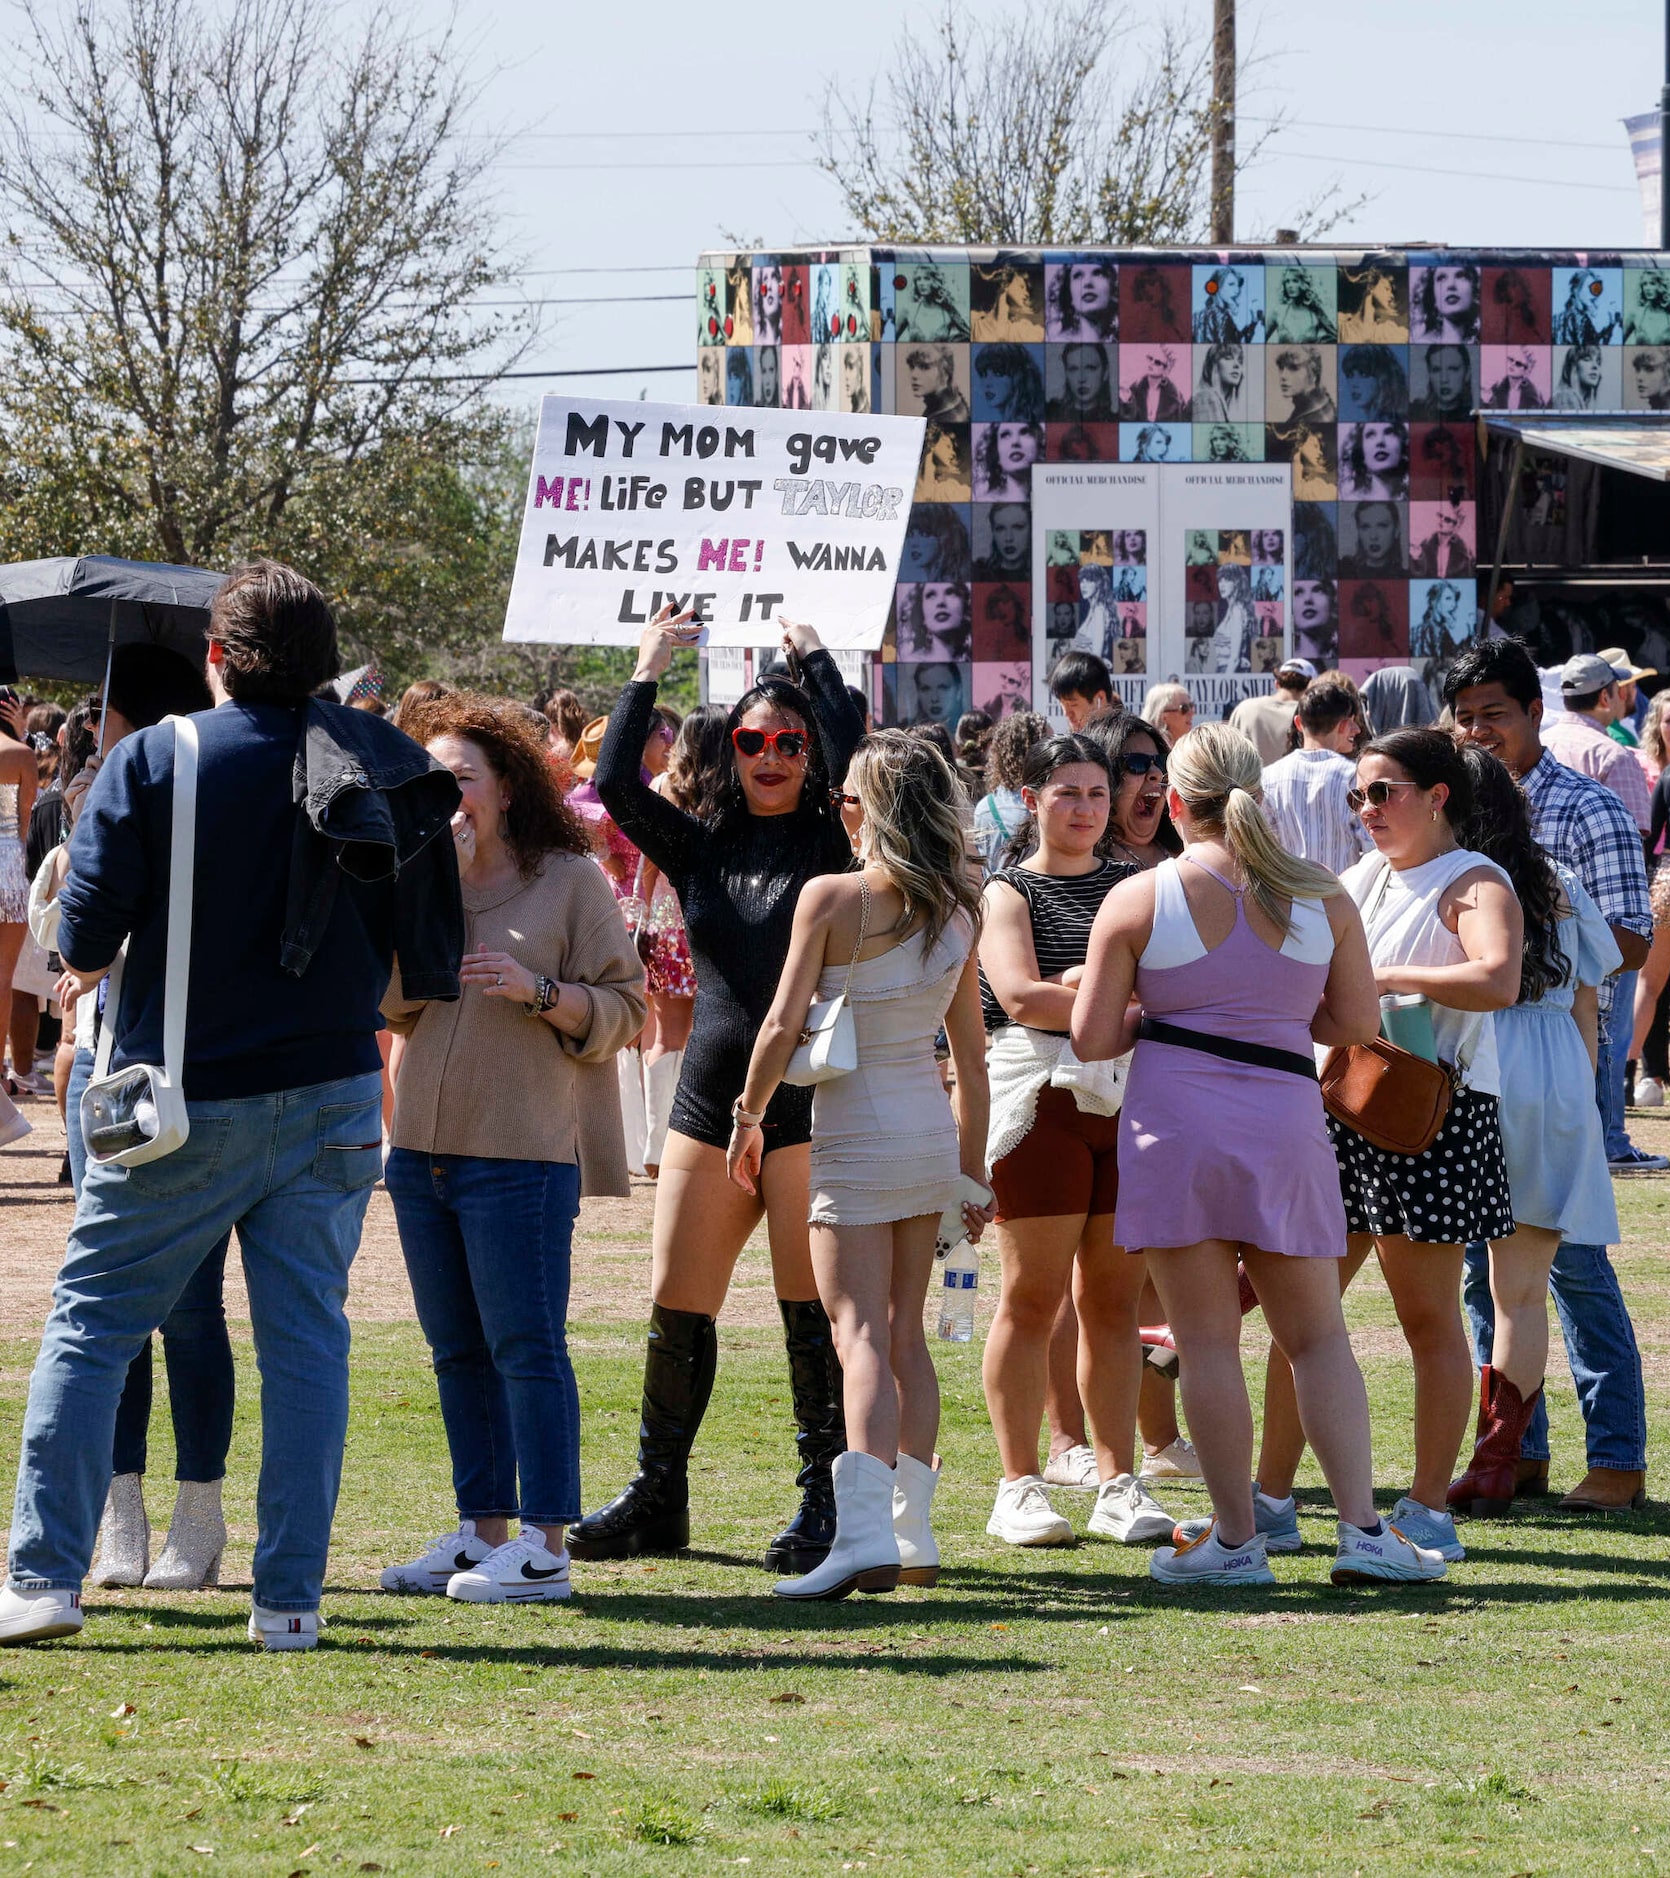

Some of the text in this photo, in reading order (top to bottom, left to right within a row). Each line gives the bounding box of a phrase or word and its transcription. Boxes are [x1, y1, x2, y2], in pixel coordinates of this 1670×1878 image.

[564, 412, 882, 474] MY MOM gave
[1045, 475, 1146, 485] OFFICIAL MERCHANDISE
[1185, 475, 1284, 485] OFFICIAL MERCHANDISE
[534, 475, 591, 512] ME!
[683, 477, 763, 513] BUT
[773, 478, 904, 521] TAYLOR
[543, 533, 888, 574] MAKES ME! WANNA
[739, 593, 784, 622] IT
[1184, 678, 1238, 703] TAYLOR
[1355, 1540, 1383, 1557] HOKA
[1223, 1555, 1253, 1571] HOKA
